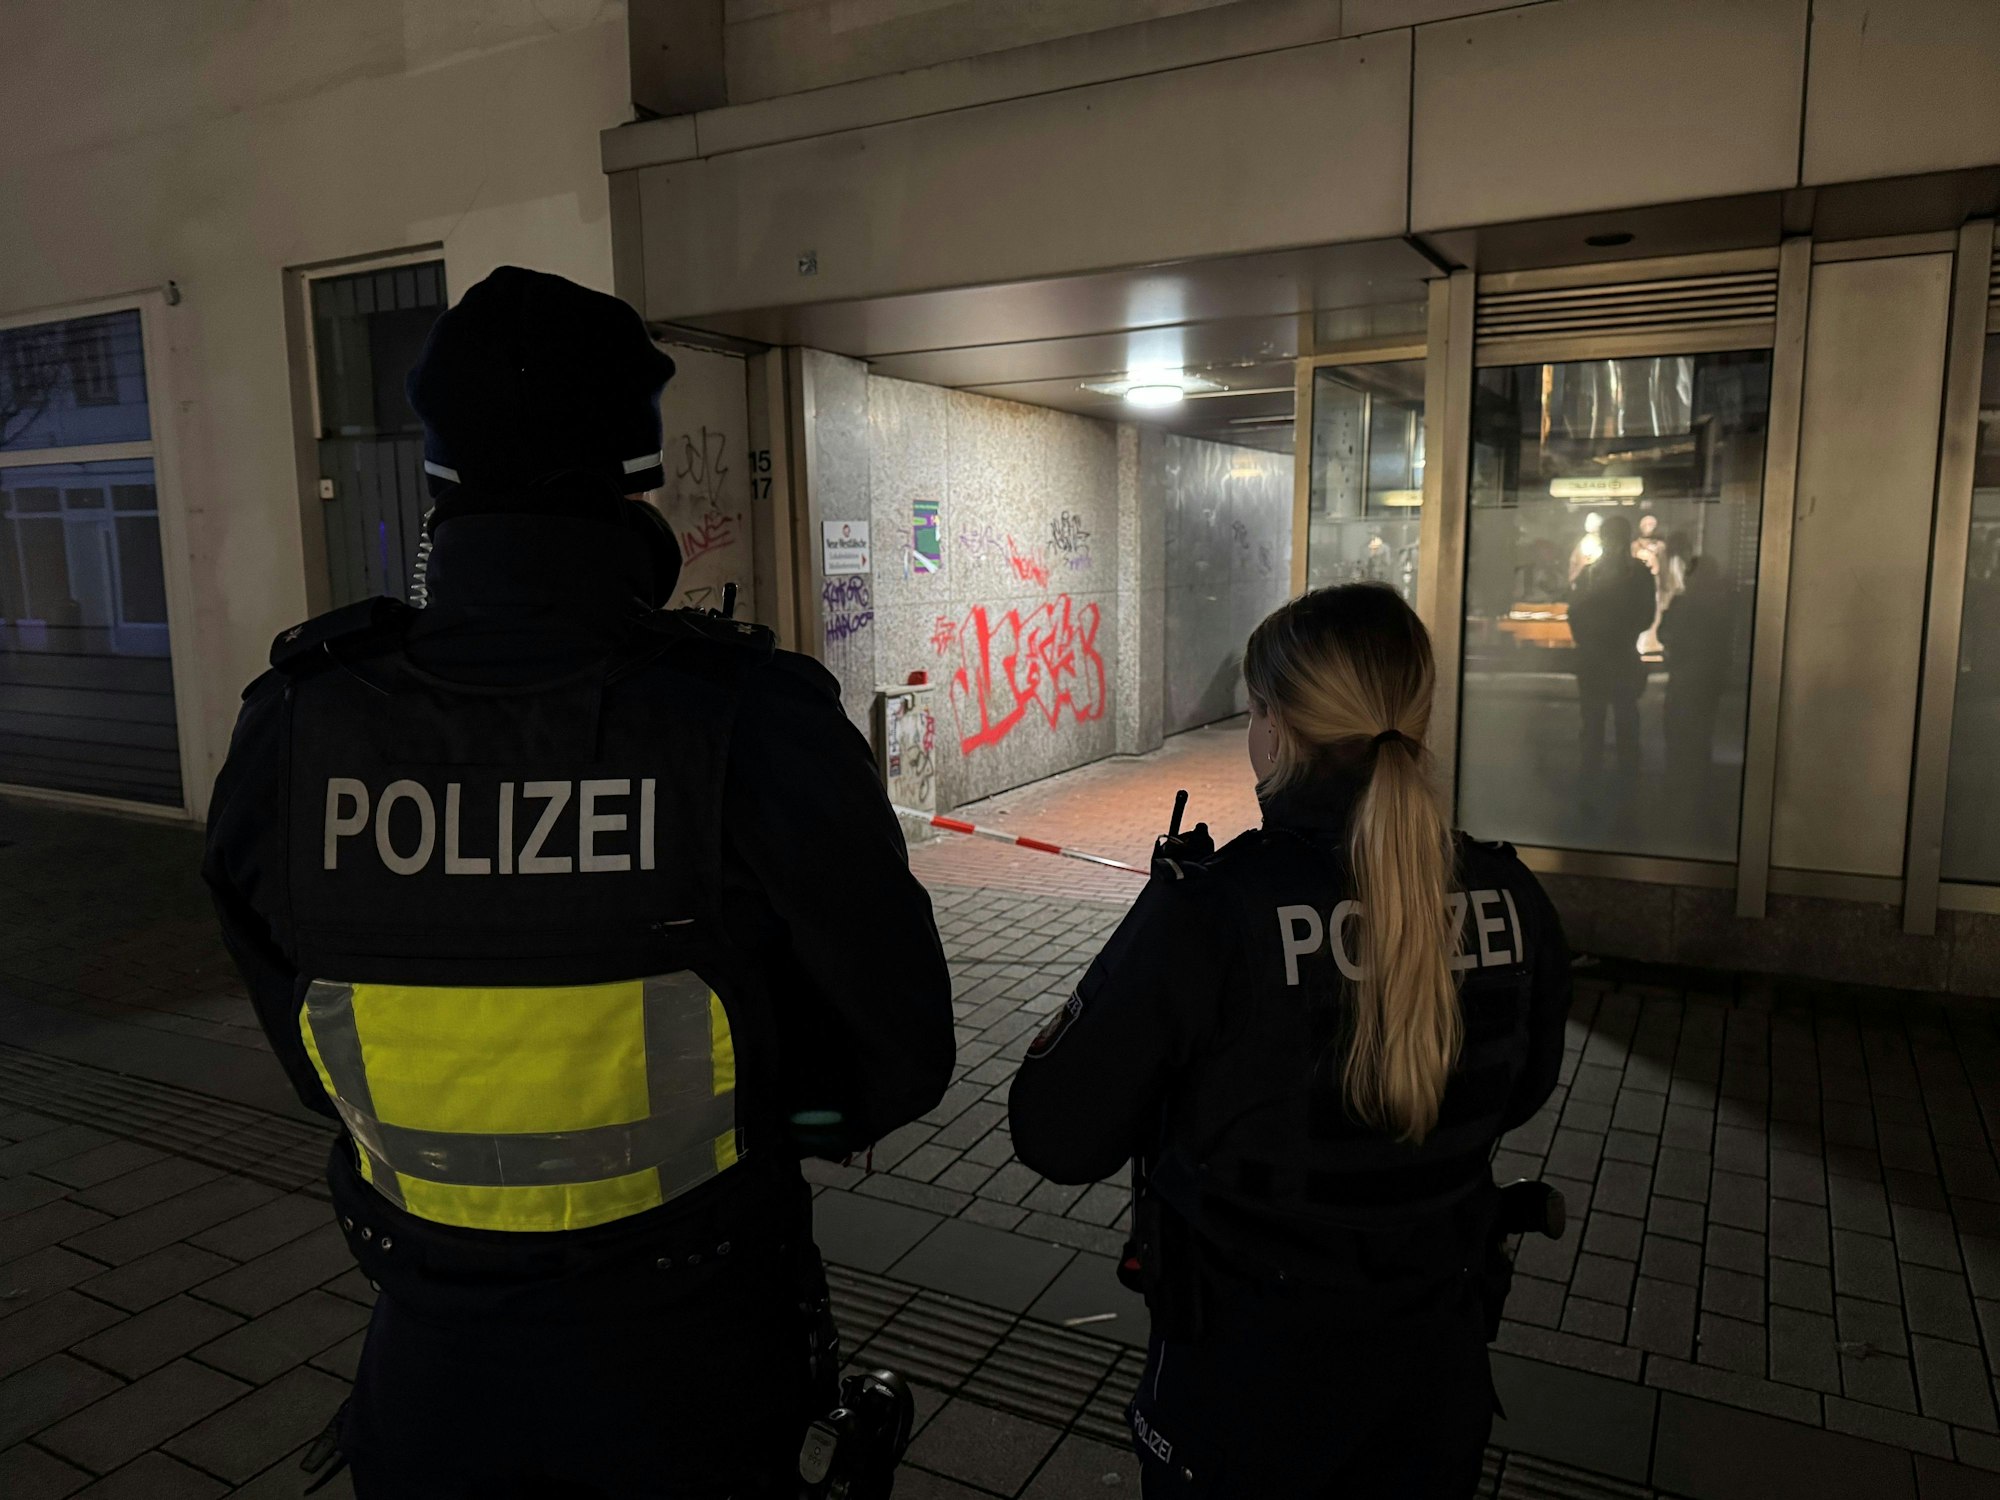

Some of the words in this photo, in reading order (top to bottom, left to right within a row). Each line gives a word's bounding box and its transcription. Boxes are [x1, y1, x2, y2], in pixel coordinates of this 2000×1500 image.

[749, 450, 771, 472] 15
[752, 478, 772, 499] 17
[323, 777, 656, 876] POLIZEI
[1276, 888, 1524, 986] POZEI
[1134, 1408, 1173, 1464] POLIZEI
